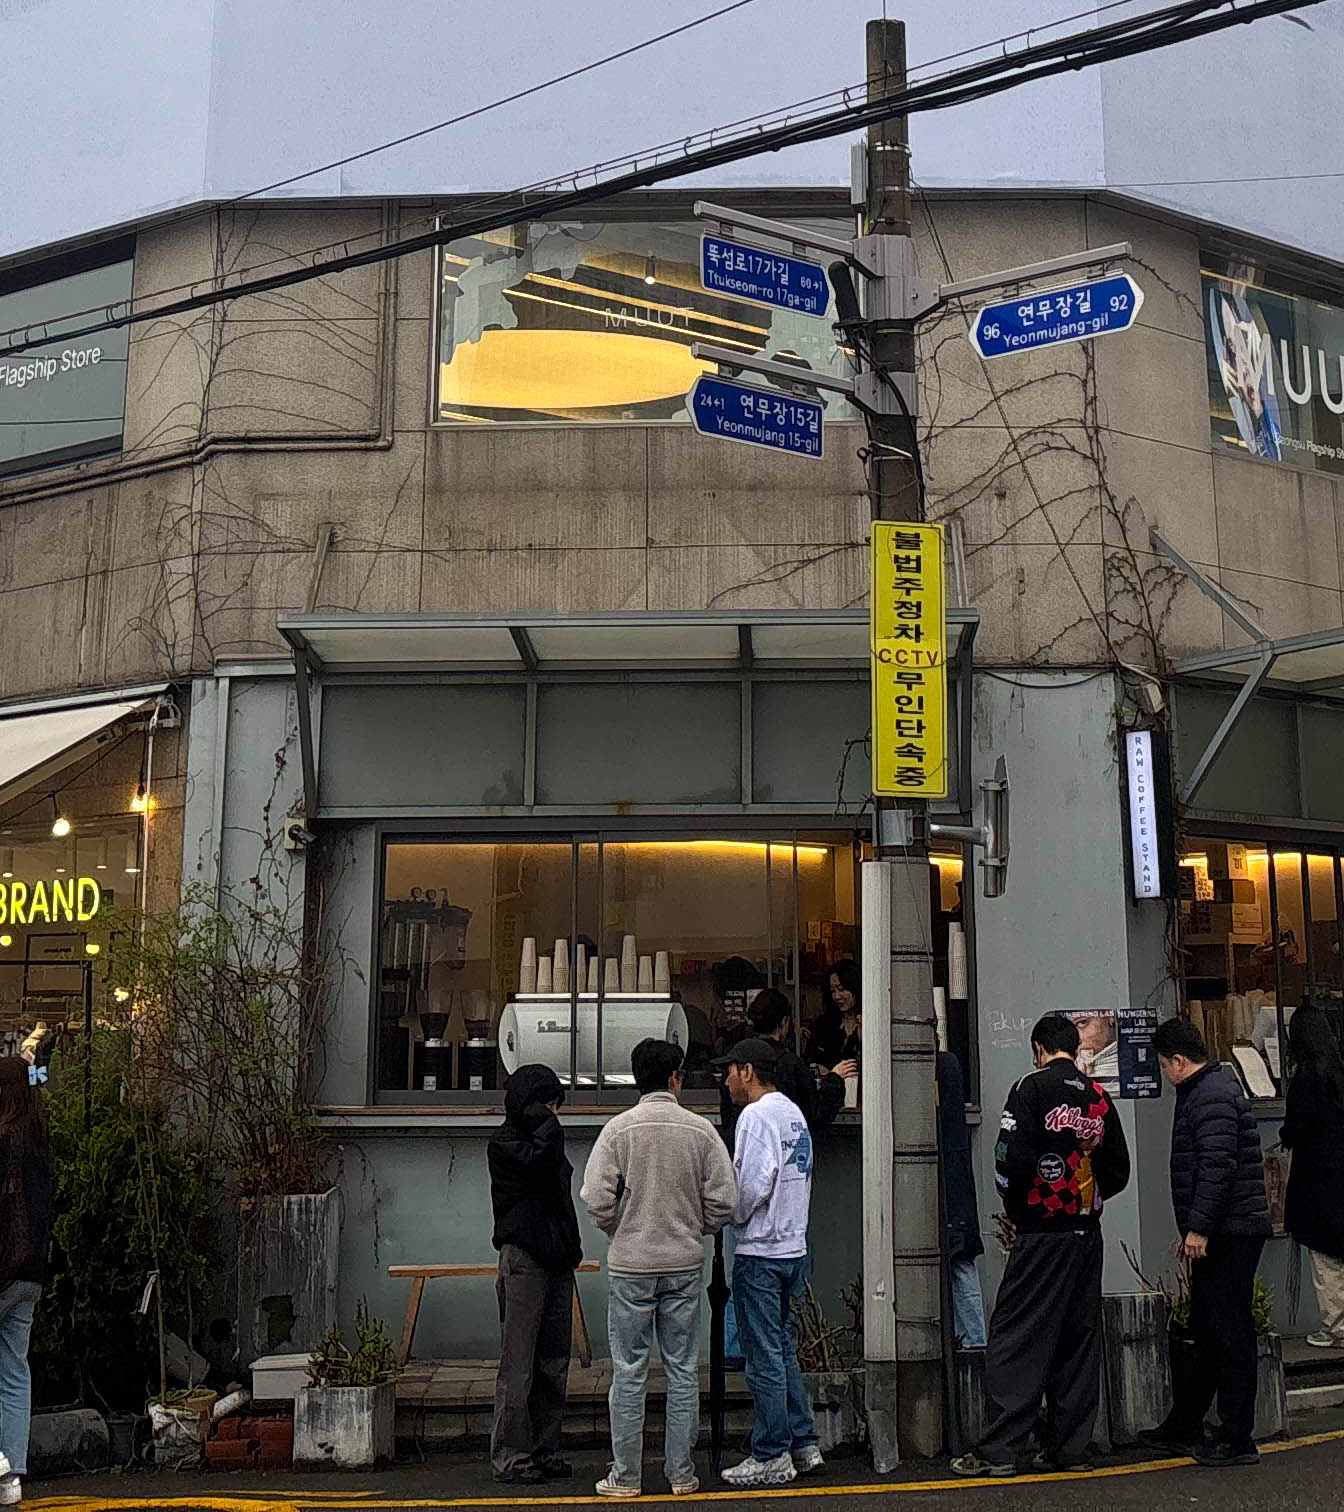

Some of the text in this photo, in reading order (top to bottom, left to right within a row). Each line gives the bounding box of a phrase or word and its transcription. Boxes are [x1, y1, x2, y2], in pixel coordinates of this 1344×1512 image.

[707, 243, 789, 285] 뚝섬로17가길
[707, 269, 817, 311] Ttukseom-ro 17ga-gil
[1017, 288, 1092, 326] 연무장길
[1109, 294, 1129, 312] 92
[983, 323, 1000, 341] 96
[1002, 311, 1109, 348] Yeonmujang-gil
[60, 347, 101, 372] Store
[716, 414, 819, 453] Yeonmujang 15-gil
[740, 394, 819, 434] 연무장15길
[891, 530, 924, 644] 불법주정차
[878, 647, 939, 666] CCTV
[893, 671, 927, 787] 무인단속중
[1135, 737, 1152, 893] RAW COFFEE STAND
